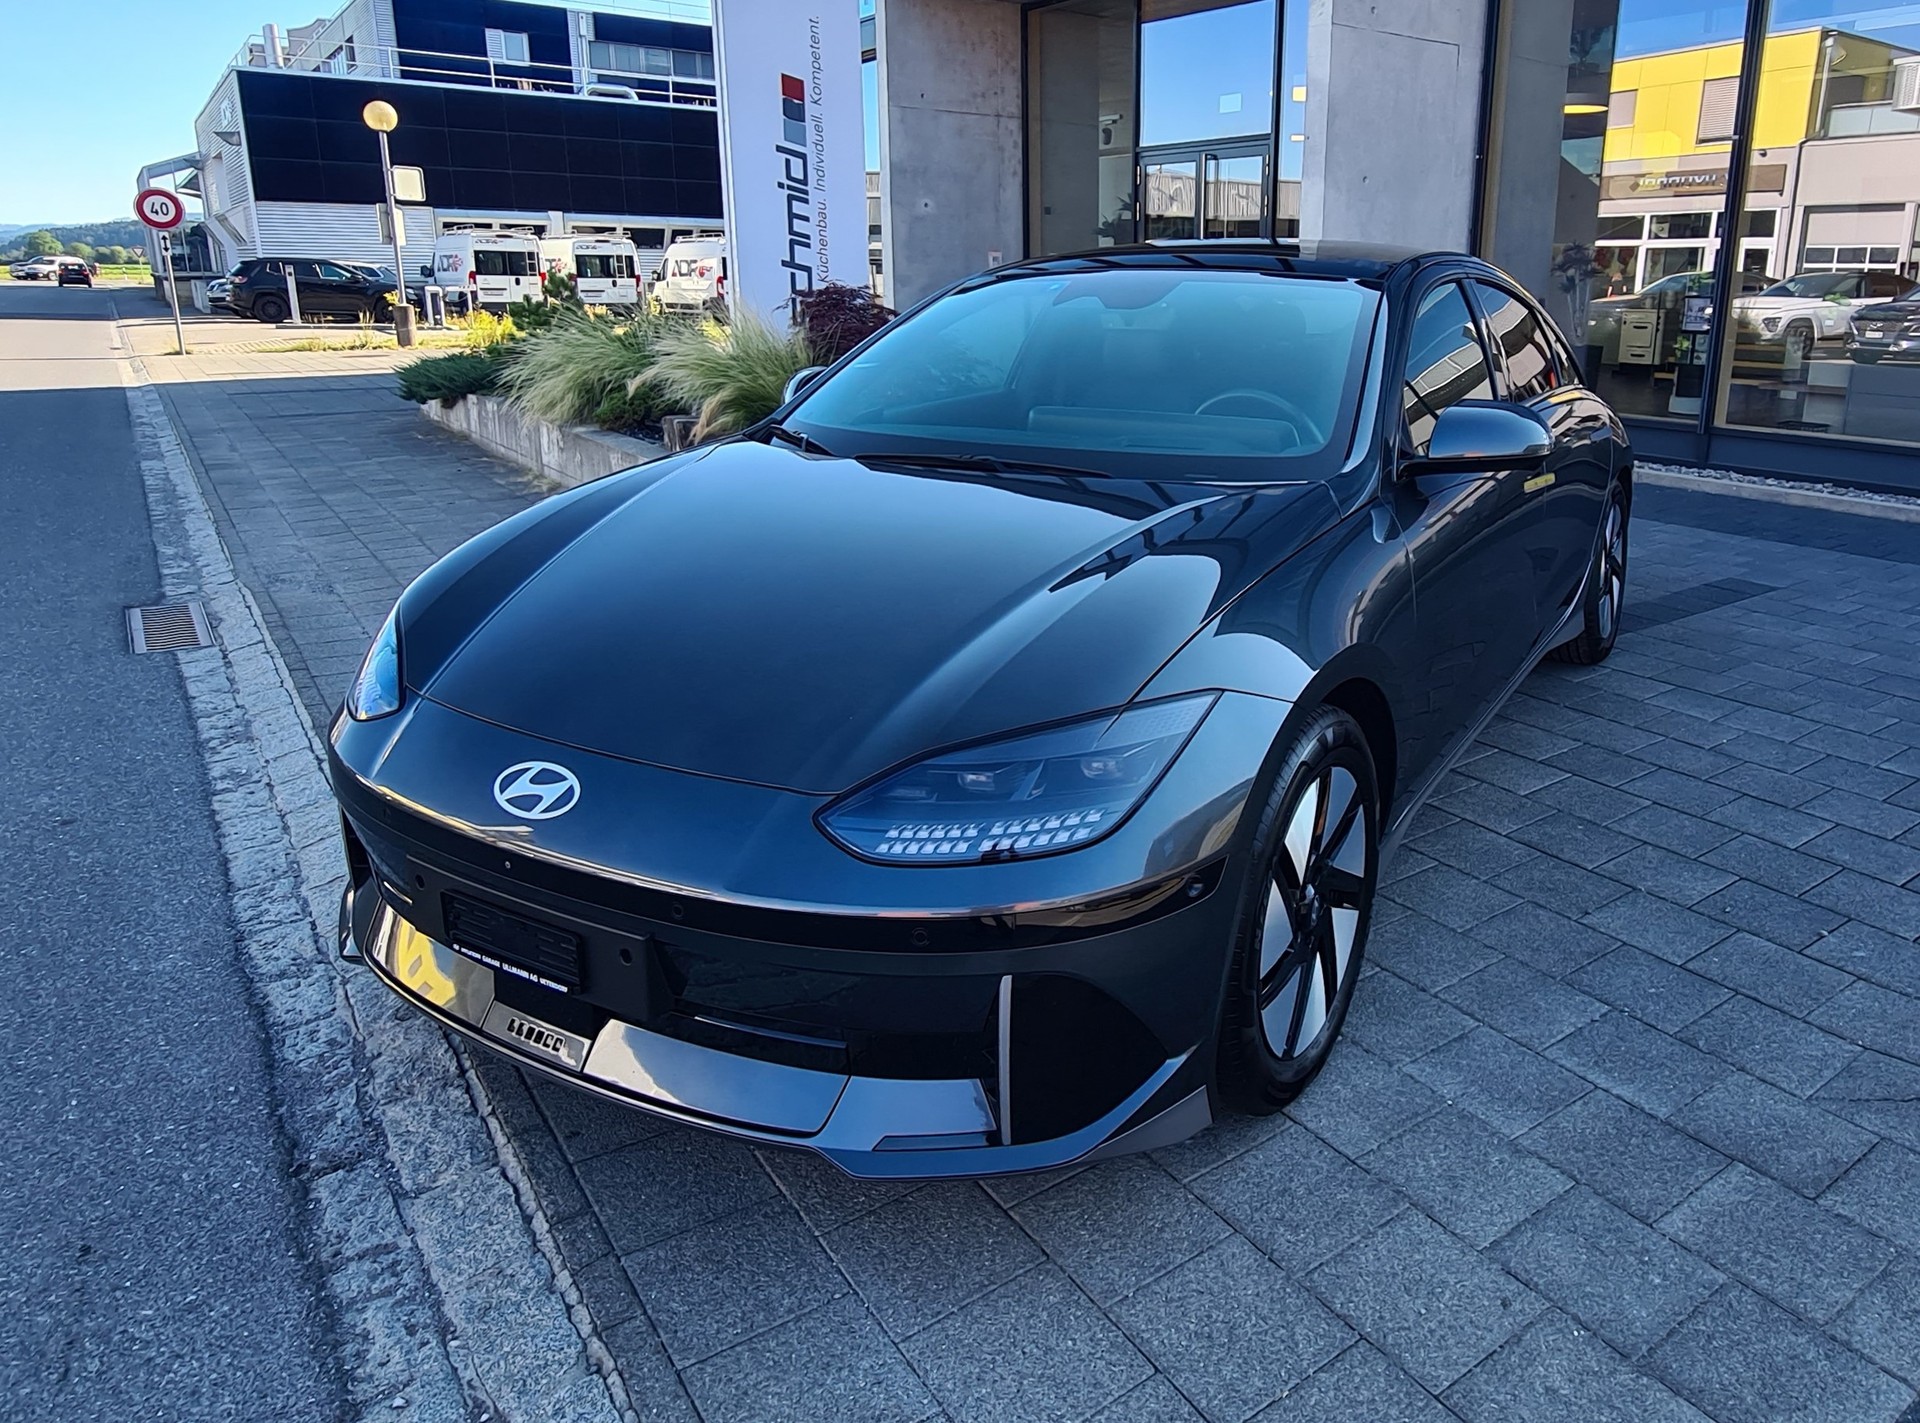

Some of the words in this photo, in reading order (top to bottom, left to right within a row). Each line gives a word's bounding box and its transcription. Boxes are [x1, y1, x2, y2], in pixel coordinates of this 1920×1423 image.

[808, 16, 825, 106] Kompetent.
[811, 113, 827, 192] Individuell.
[150, 201, 170, 217] 40
[776, 144, 814, 325] chmid
[815, 198, 830, 284] Küchenbau.
